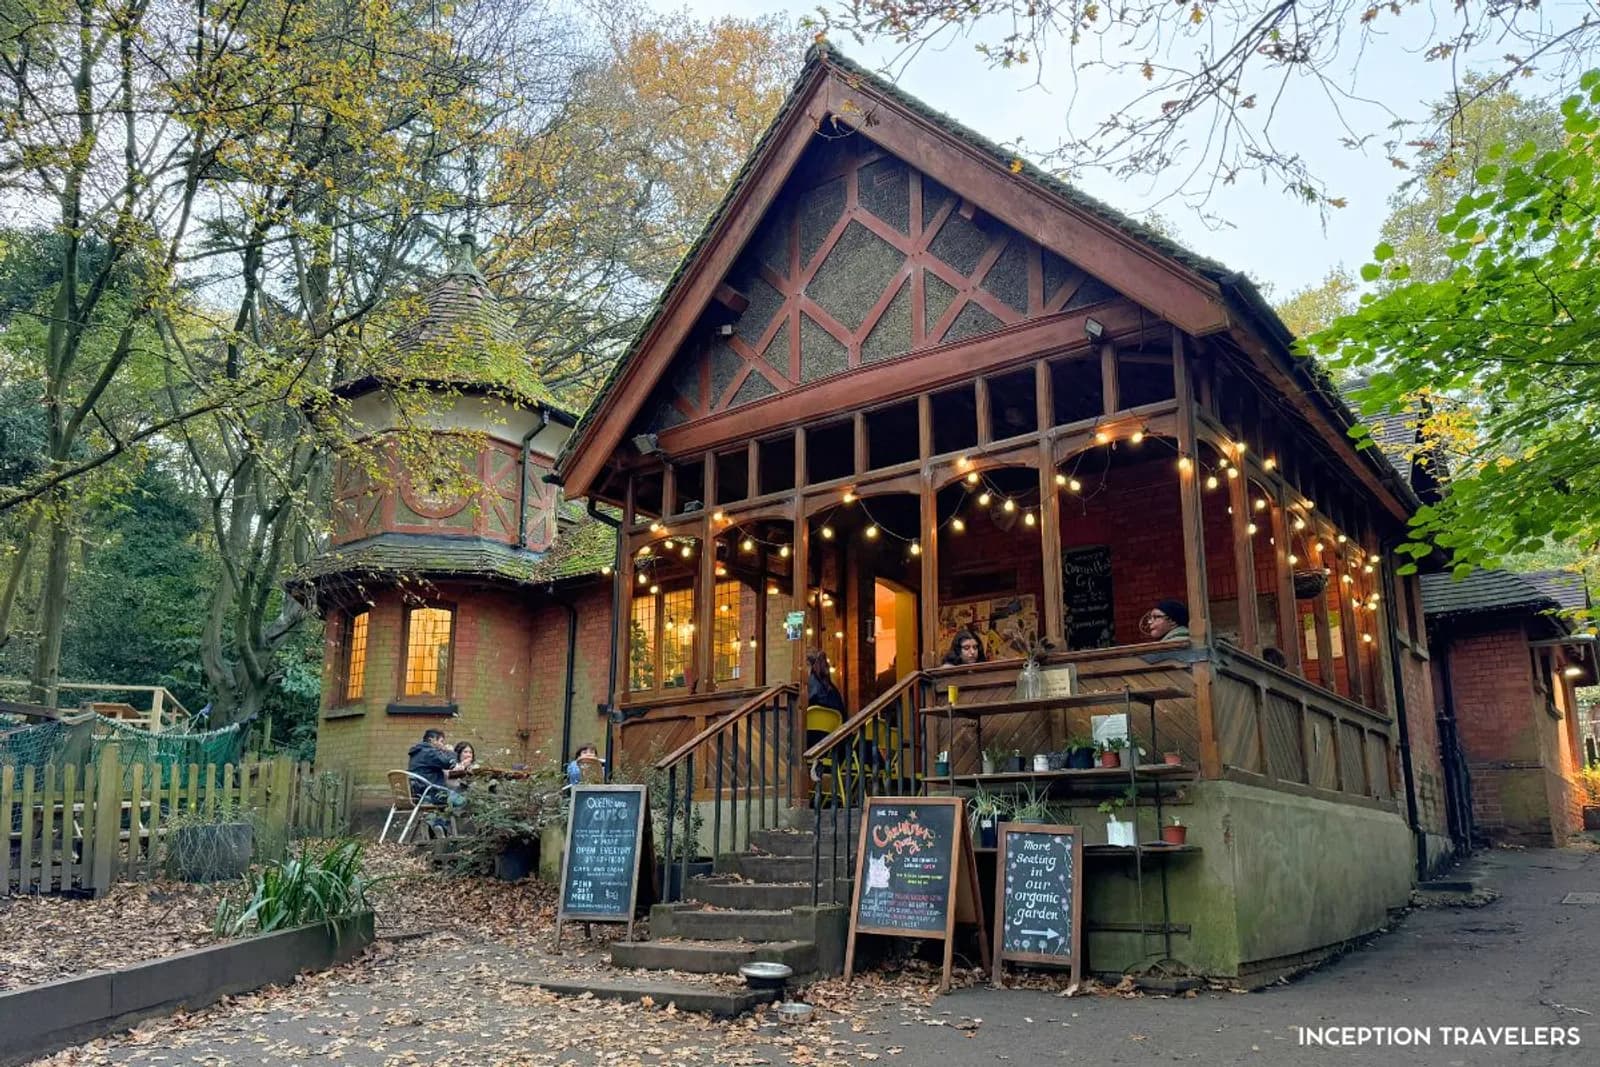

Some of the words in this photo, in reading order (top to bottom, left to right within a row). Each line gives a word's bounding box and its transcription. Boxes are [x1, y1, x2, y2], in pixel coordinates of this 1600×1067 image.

[575, 846, 596, 855] OPEN
[1024, 839, 1051, 851] More
[1030, 866, 1043, 877] in
[1025, 879, 1051, 890] our
[1015, 891, 1059, 909] organic
[1013, 906, 1059, 926] garden
